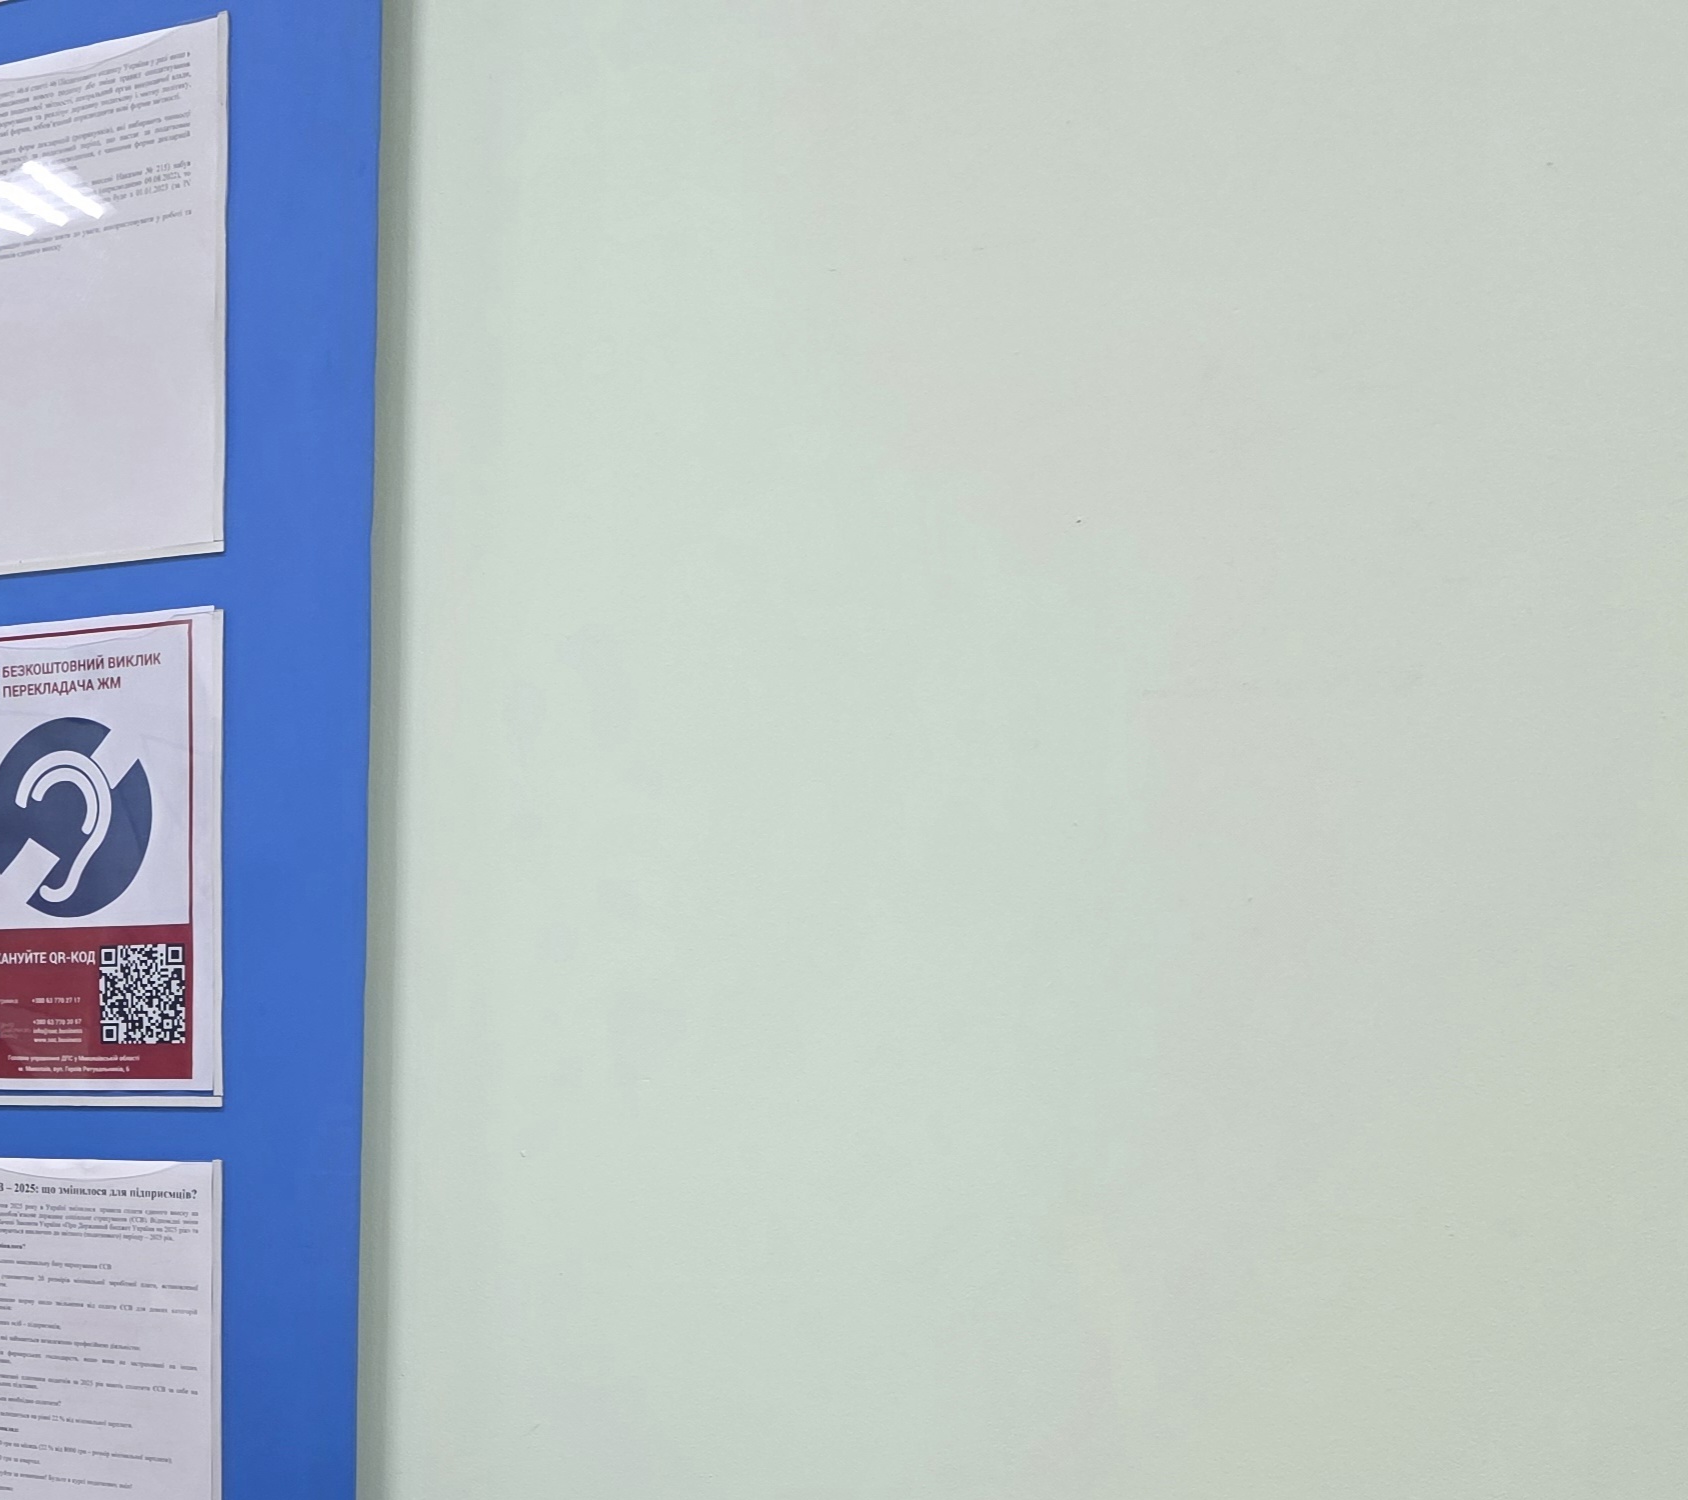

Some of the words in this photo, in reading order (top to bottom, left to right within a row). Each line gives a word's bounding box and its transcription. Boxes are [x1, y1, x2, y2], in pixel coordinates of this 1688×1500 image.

[2, 655, 104, 678] БЕЗКОШТОВНИЙ
[108, 653, 161, 668] ВИКЛИК
[3, 680, 94, 698] ПЕРЕКЛАДАЧА
[98, 677, 121, 689] ЖМ
[49, 951, 96, 966] QR-КОД
[14, 1184, 39, 1193] 2025:
[41, 1186, 56, 1195] що
[58, 1186, 107, 1197] змінилося
[109, 1188, 127, 1197] для
[130, 1189, 197, 1200] підприємців?
